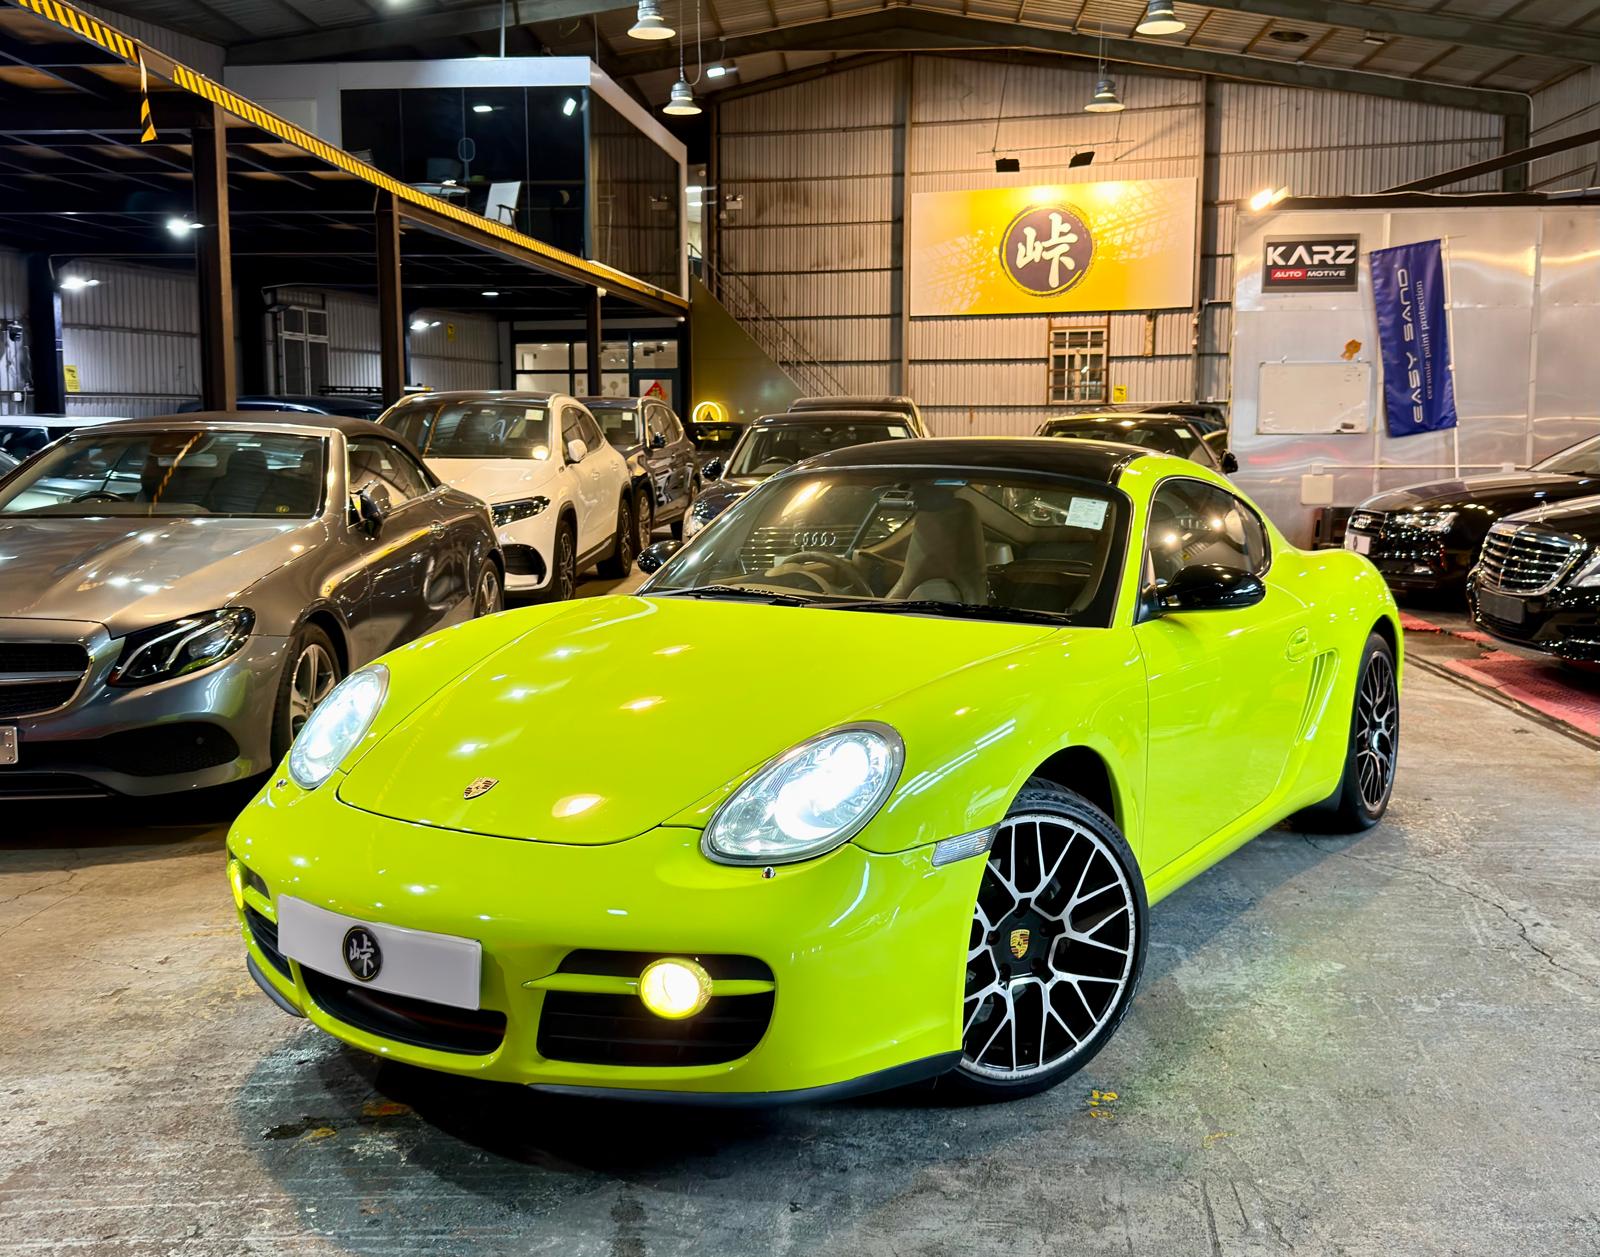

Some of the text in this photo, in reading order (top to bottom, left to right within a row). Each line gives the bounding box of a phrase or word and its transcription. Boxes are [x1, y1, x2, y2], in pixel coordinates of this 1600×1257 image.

[1016, 212, 1078, 288] 峠
[1267, 245, 1356, 266] KARZ
[1397, 268, 1424, 423] EASY SAND
[1415, 280, 1433, 400] ceramic paint protection
[349, 933, 375, 977] 峠
